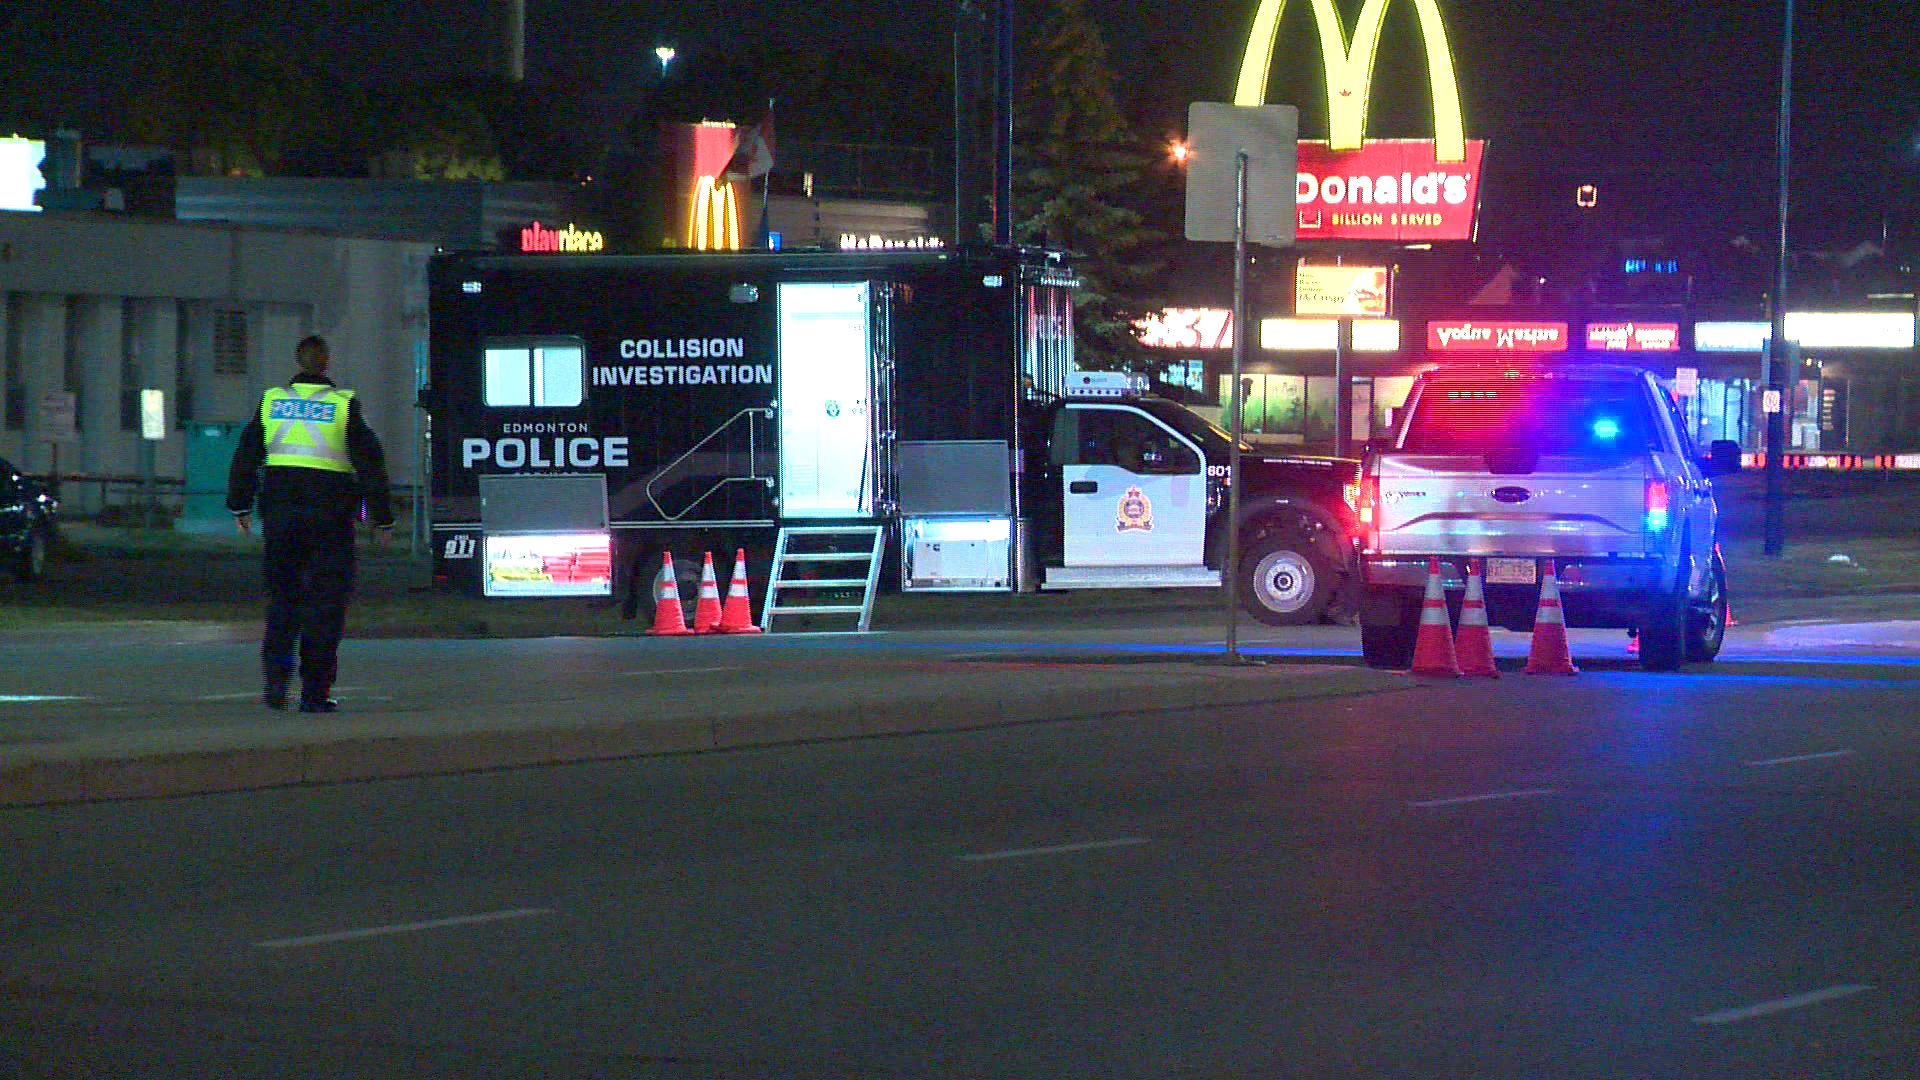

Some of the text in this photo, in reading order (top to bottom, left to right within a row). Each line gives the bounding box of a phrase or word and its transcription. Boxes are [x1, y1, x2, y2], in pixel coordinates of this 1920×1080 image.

[1332, 213, 1443, 225] BILLION SERVED
[621, 338, 744, 358] COLLISION
[592, 364, 773, 386] INVESTIGATION
[273, 401, 335, 420] POLICE
[503, 423, 587, 433] EDMONTON
[462, 437, 629, 468] POLICE
